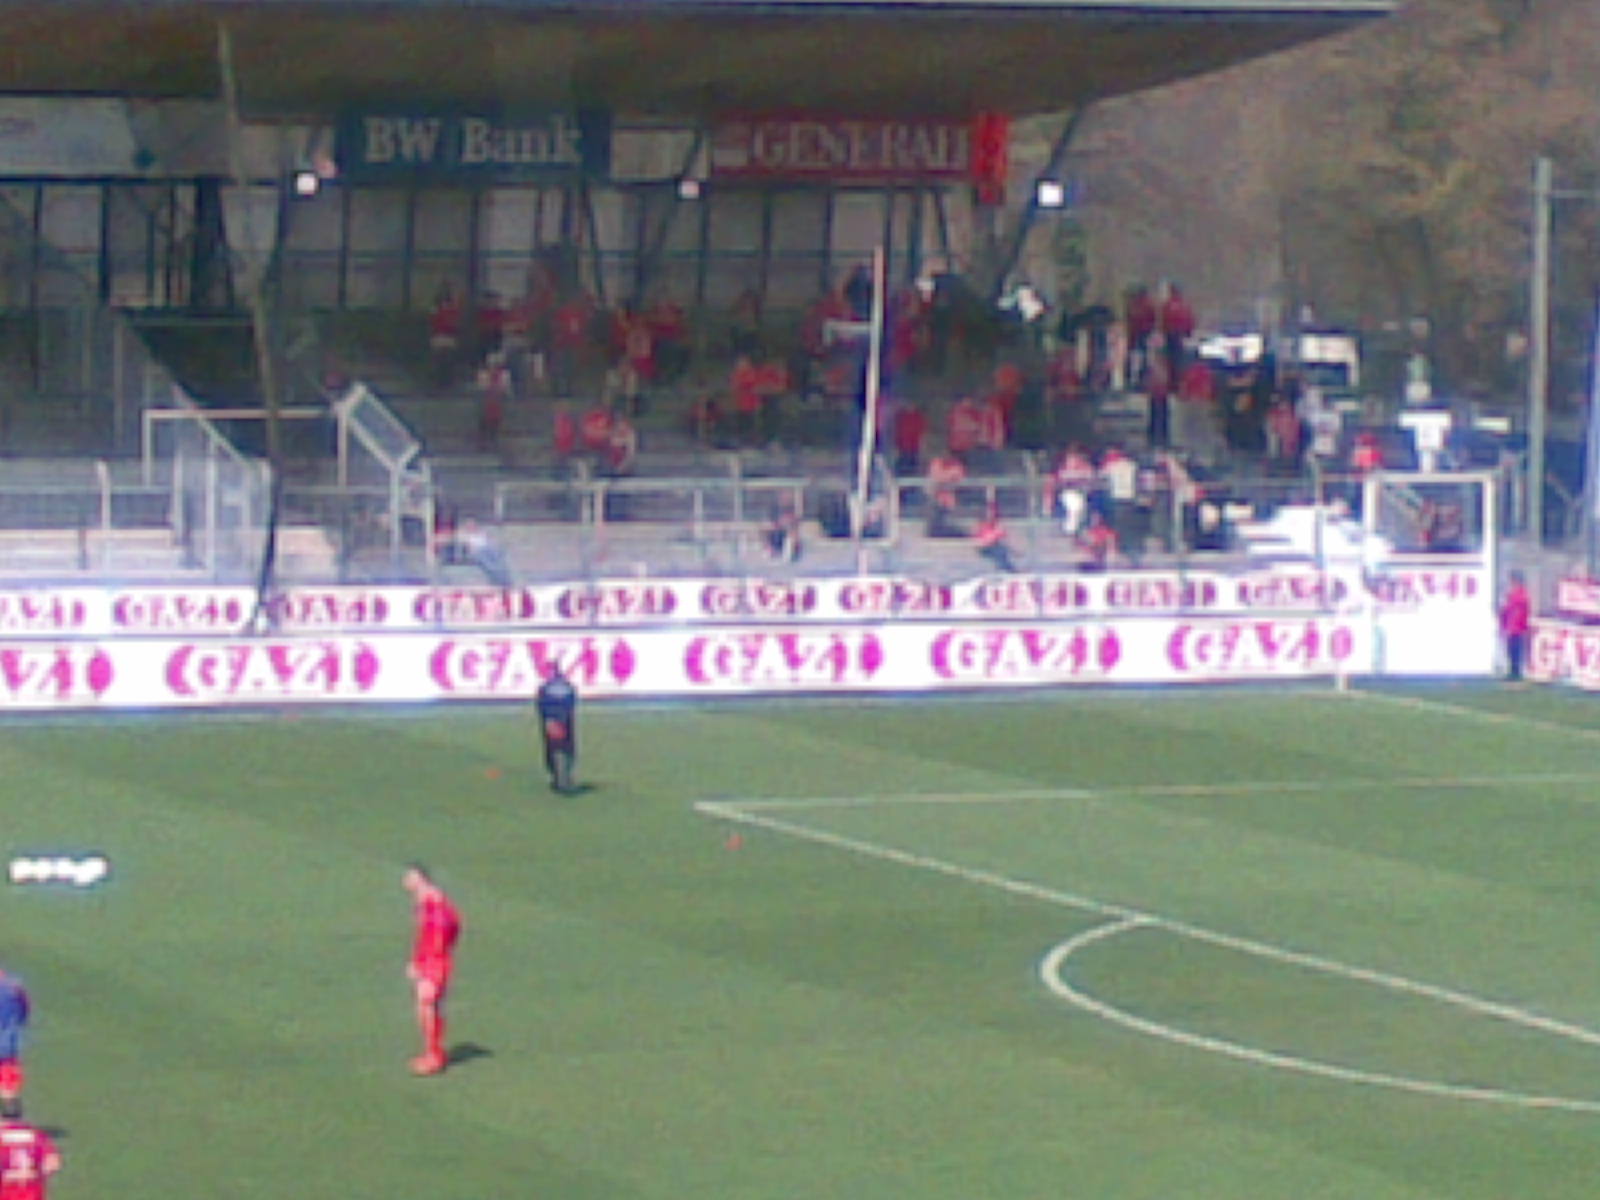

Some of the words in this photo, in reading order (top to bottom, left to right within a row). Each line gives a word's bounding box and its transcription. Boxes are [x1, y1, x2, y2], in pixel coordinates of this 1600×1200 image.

[363, 115, 442, 163] BW
[461, 113, 583, 164] Bank
[753, 120, 970, 168] GENERALI
